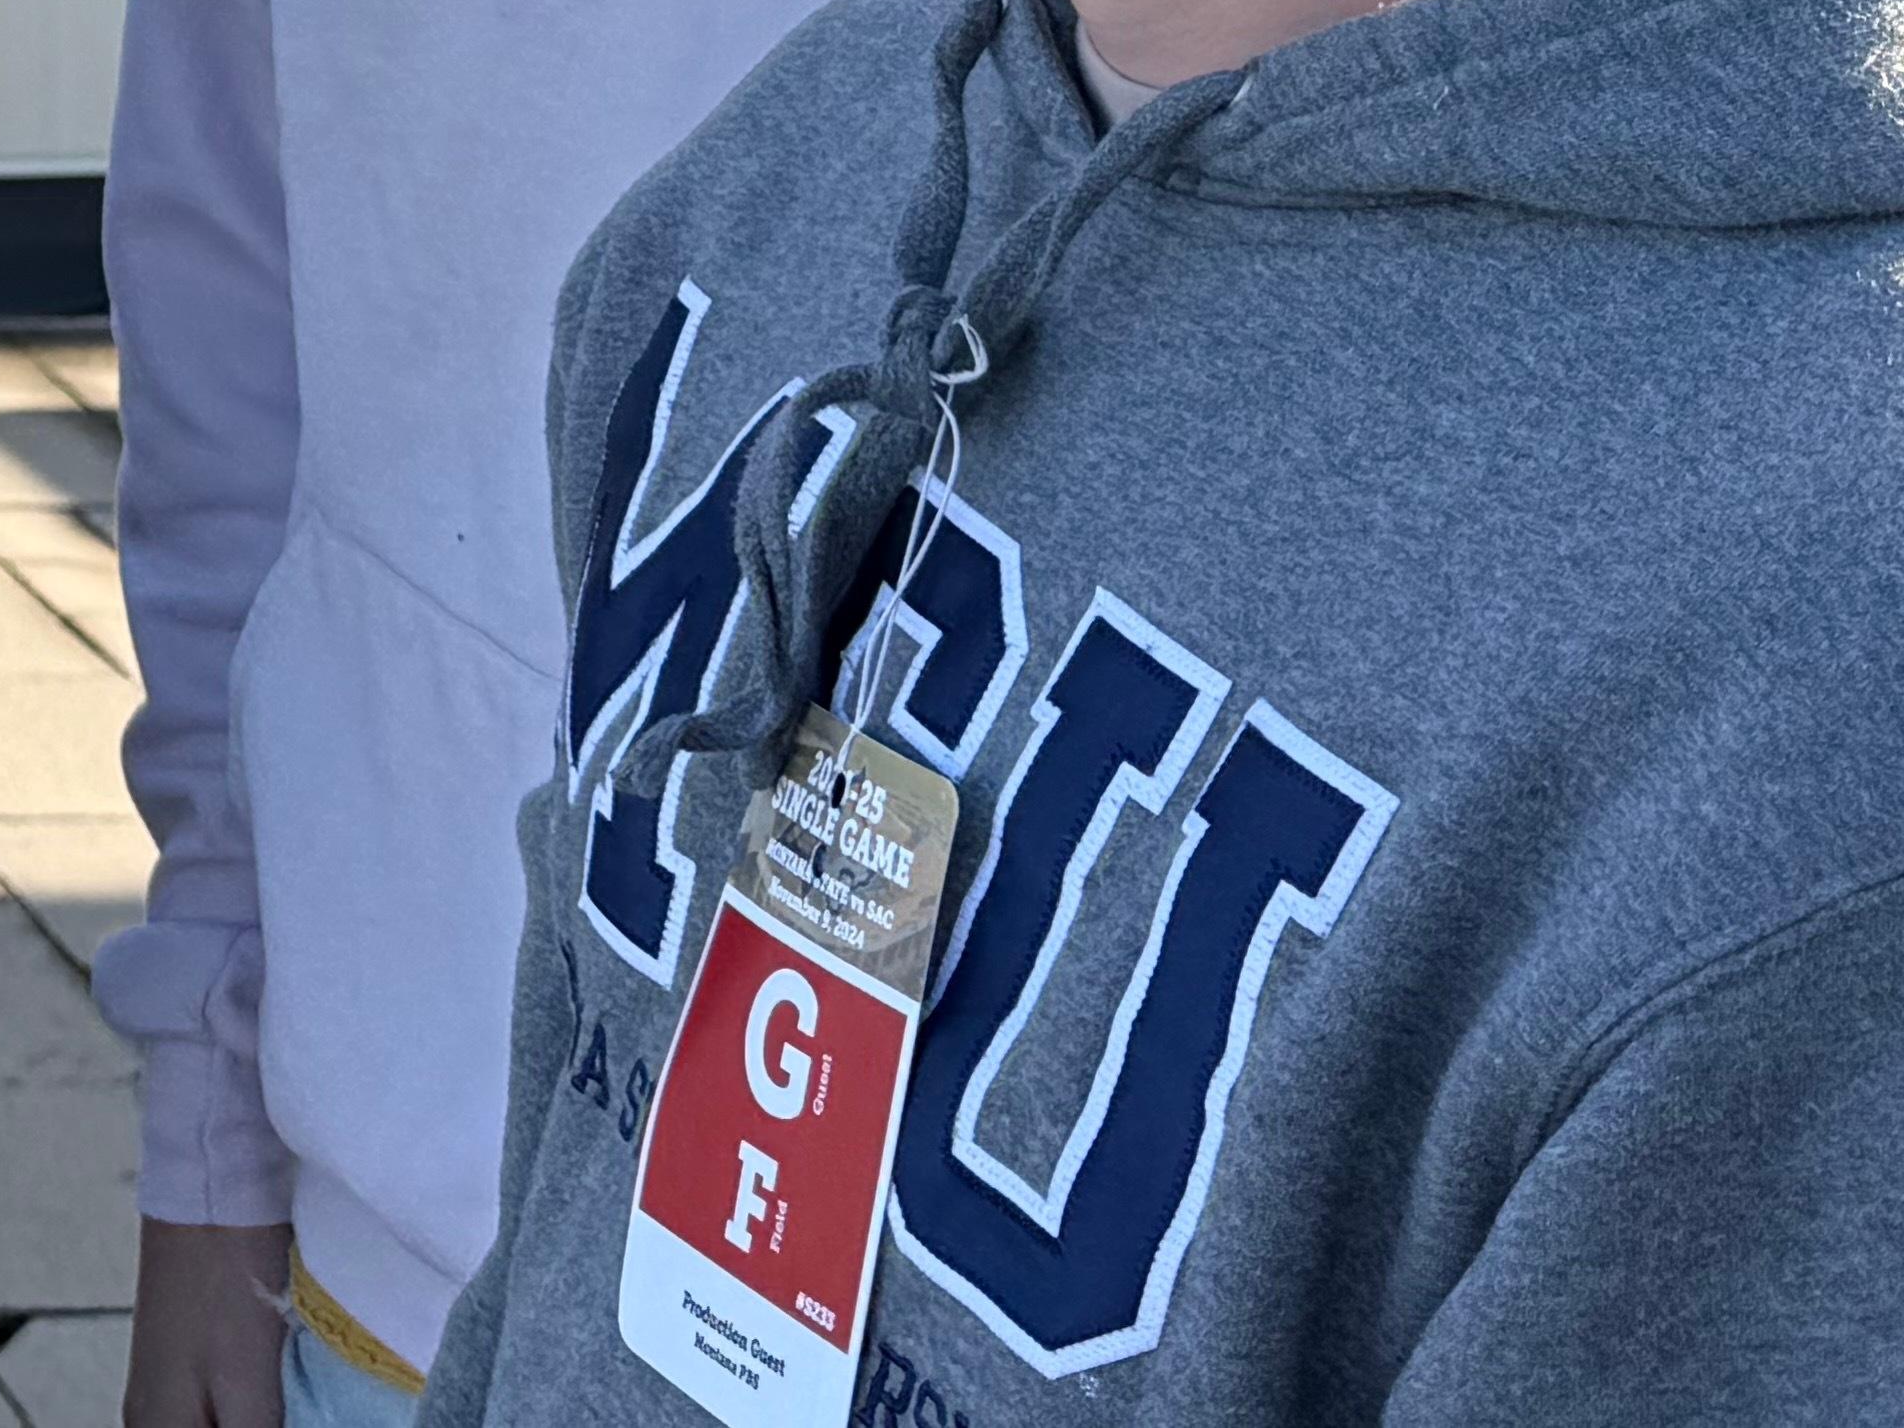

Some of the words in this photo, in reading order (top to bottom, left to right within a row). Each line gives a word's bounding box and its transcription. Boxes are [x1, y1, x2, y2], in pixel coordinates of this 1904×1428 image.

[771, 775, 841, 846] SINGLE
[839, 816, 915, 889] GAME
[768, 875, 822, 926] November
[833, 917, 866, 949] 2024
[813, 869, 851, 905] TATE
[865, 900, 895, 931] SAC
[744, 967, 819, 1120] G
[812, 1053, 833, 1116] Guest
[724, 1139, 779, 1254] F
[769, 1199, 789, 1254] Field
[682, 1289, 748, 1352] Production
[750, 1337, 786, 1378] Guest
[694, 1331, 738, 1377] Montana
[738, 1363, 760, 1391] PBS
